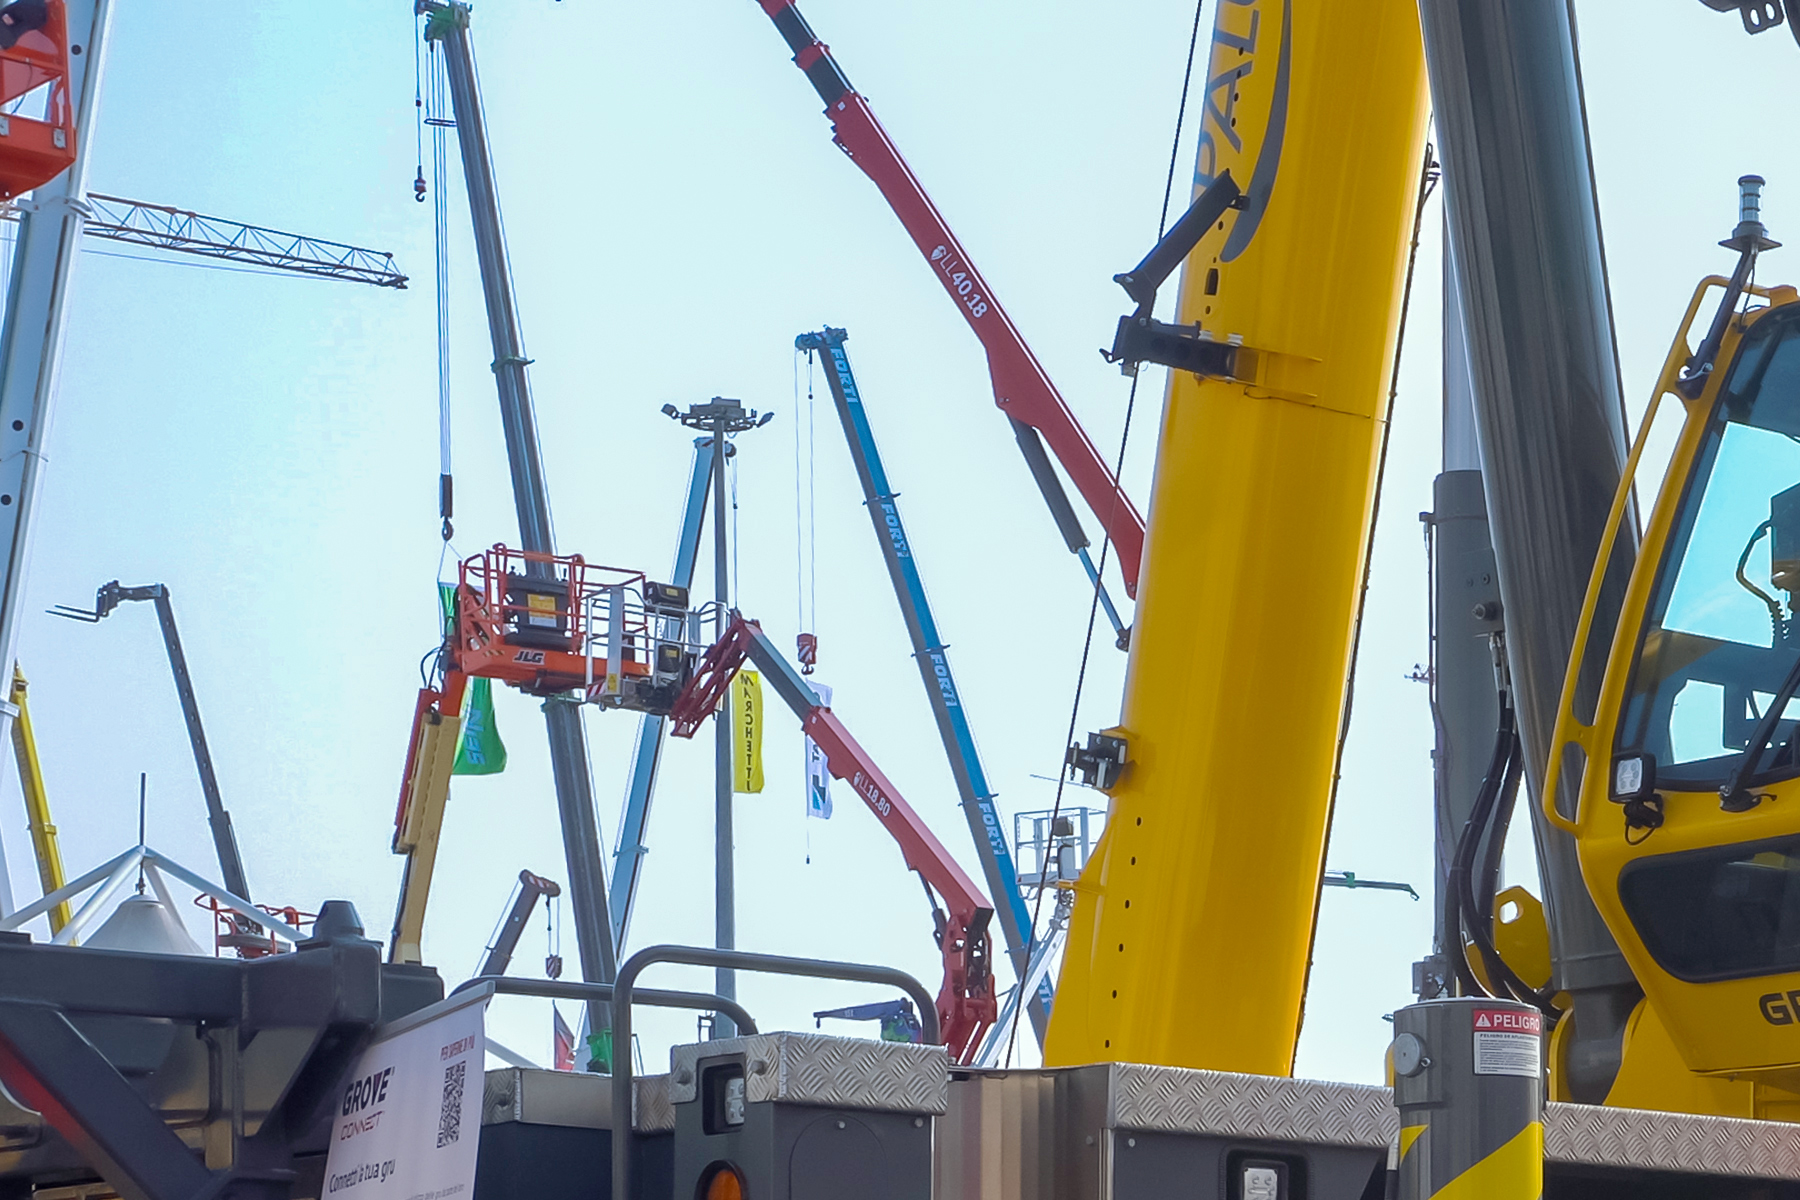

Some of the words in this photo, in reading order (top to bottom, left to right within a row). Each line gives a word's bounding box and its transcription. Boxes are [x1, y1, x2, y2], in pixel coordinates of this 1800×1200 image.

[1194, 0, 1260, 196] PAL
[512, 651, 545, 664] JLG
[1493, 1014, 1540, 1031] PELIGRO
[342, 1068, 391, 1117] GROVE
[364, 1163, 380, 1182] tua
